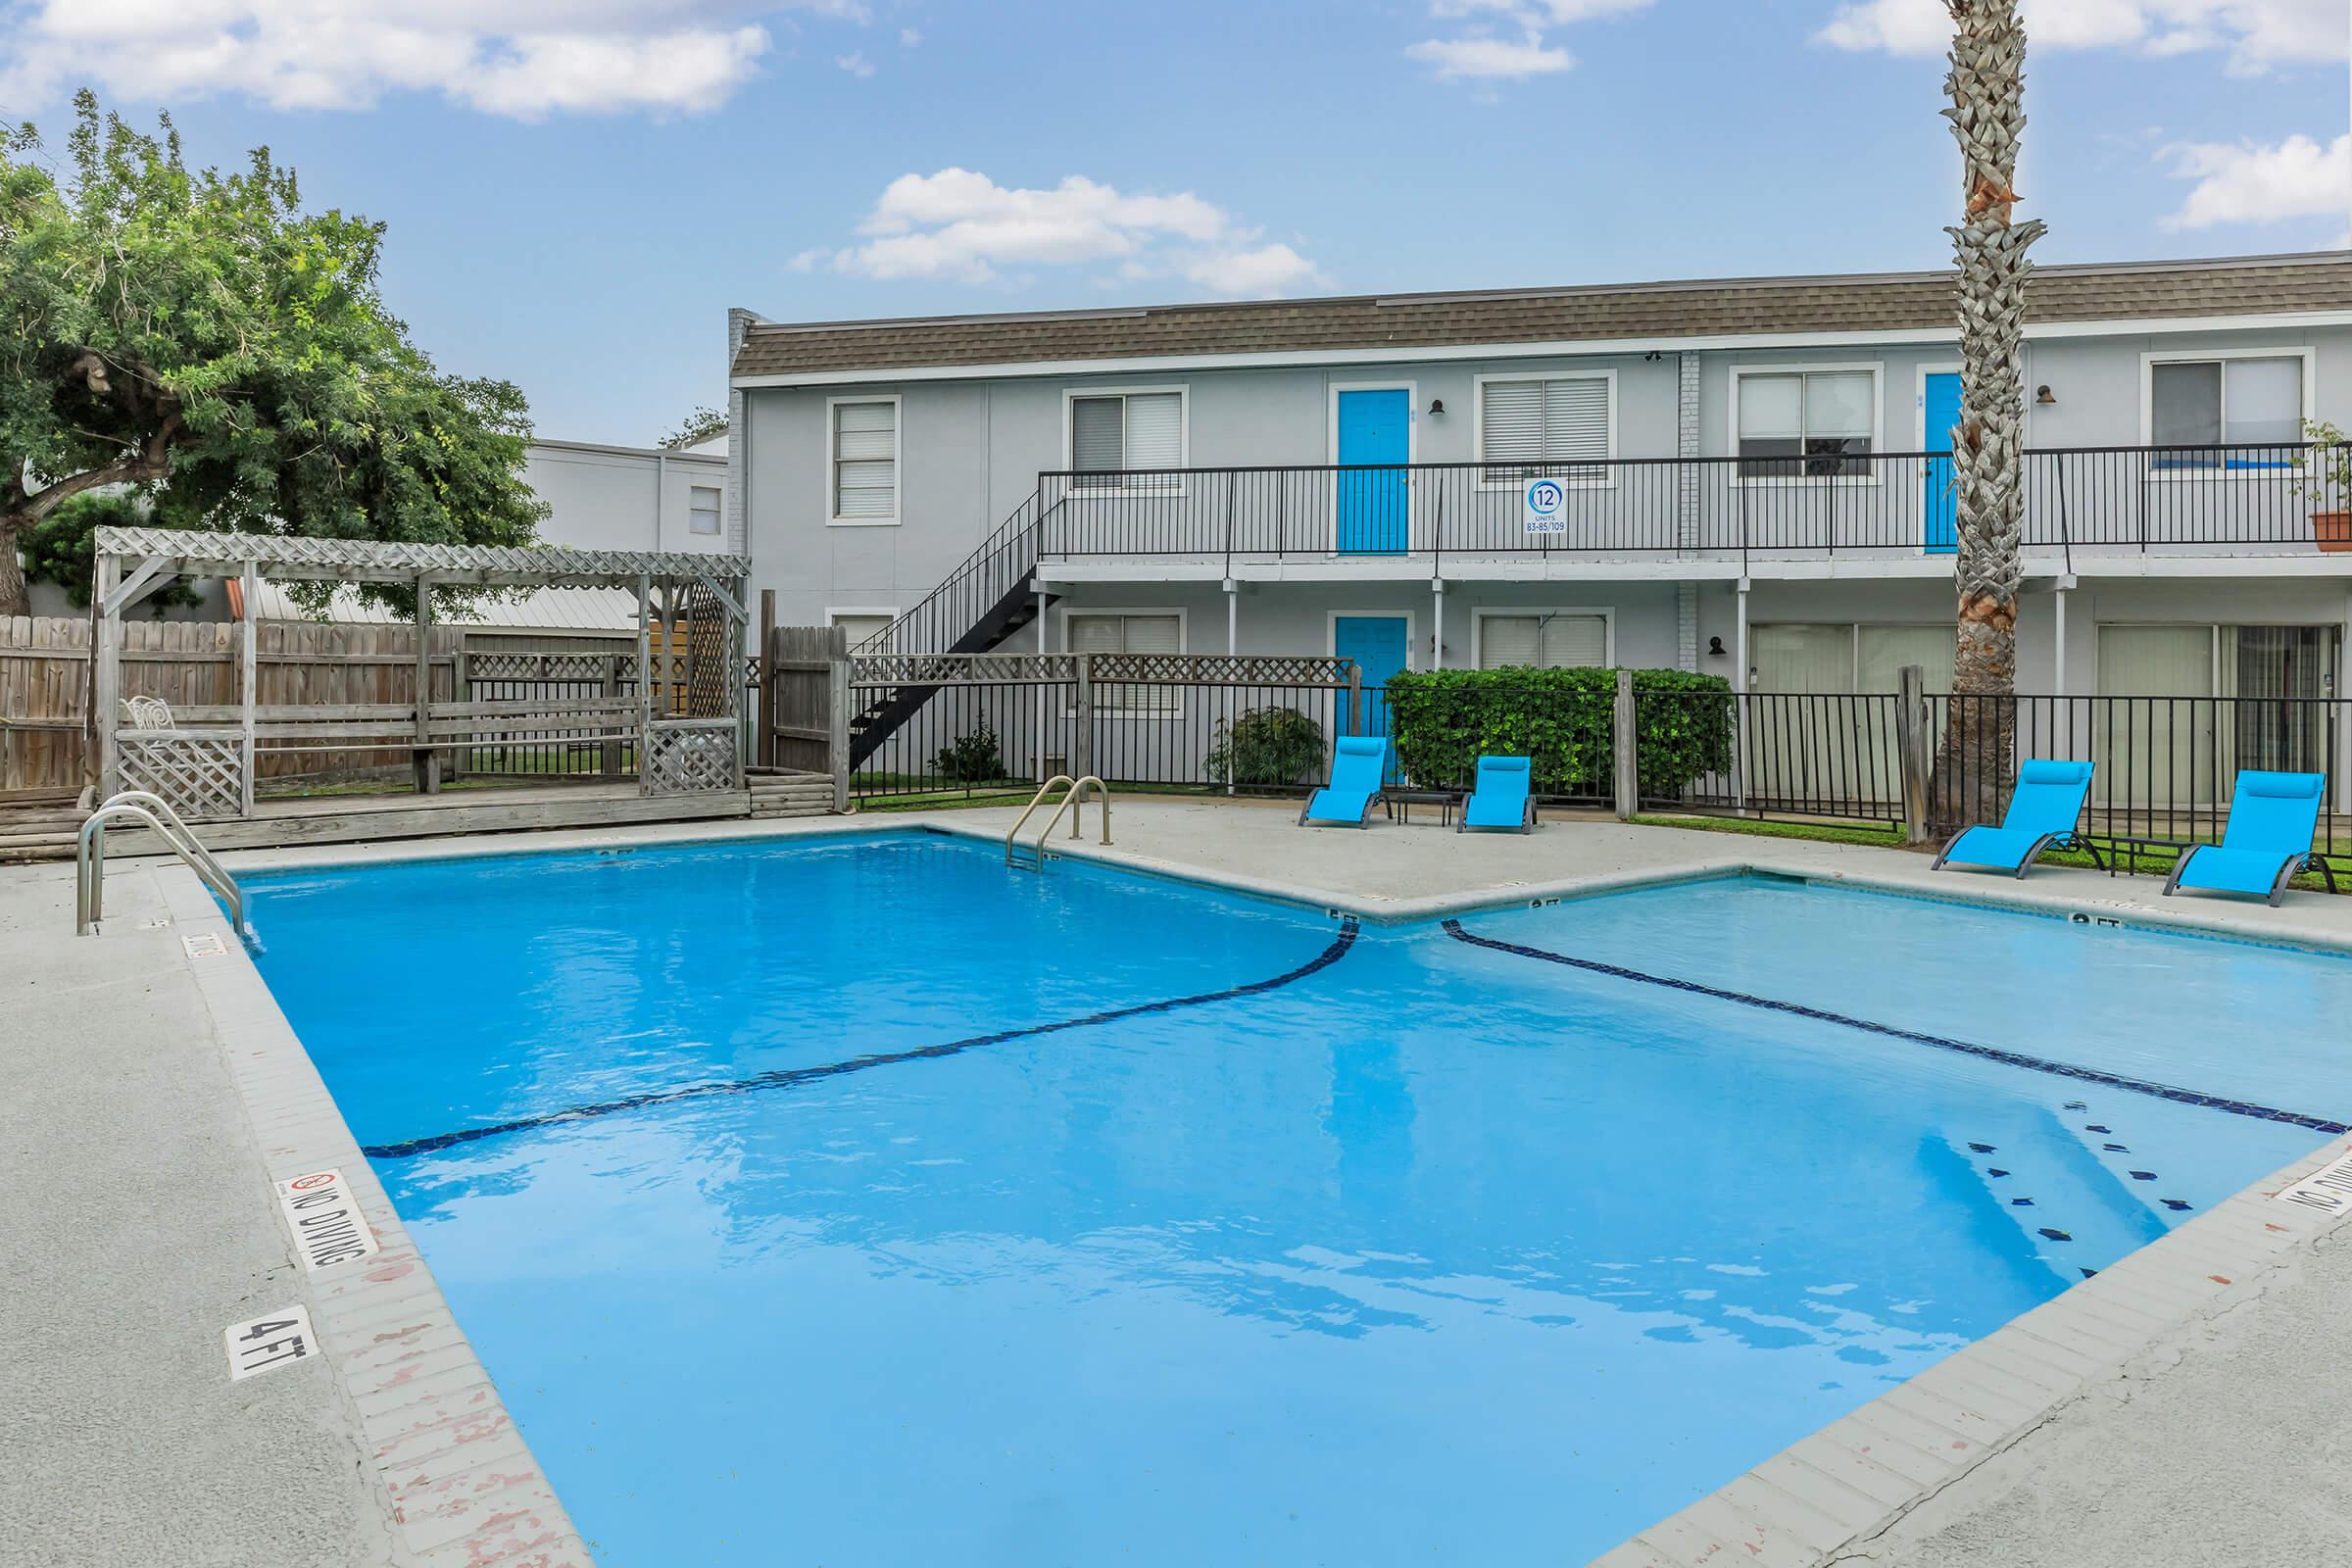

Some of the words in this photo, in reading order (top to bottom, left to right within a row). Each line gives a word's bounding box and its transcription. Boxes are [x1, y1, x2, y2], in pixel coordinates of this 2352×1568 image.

[1537, 489, 1554, 507] 12
[1527, 521, 1565, 532] 83-85/109
[289, 1187, 340, 1210] NO
[2286, 1191, 2343, 1212] NO
[298, 1208, 367, 1268] DIVING
